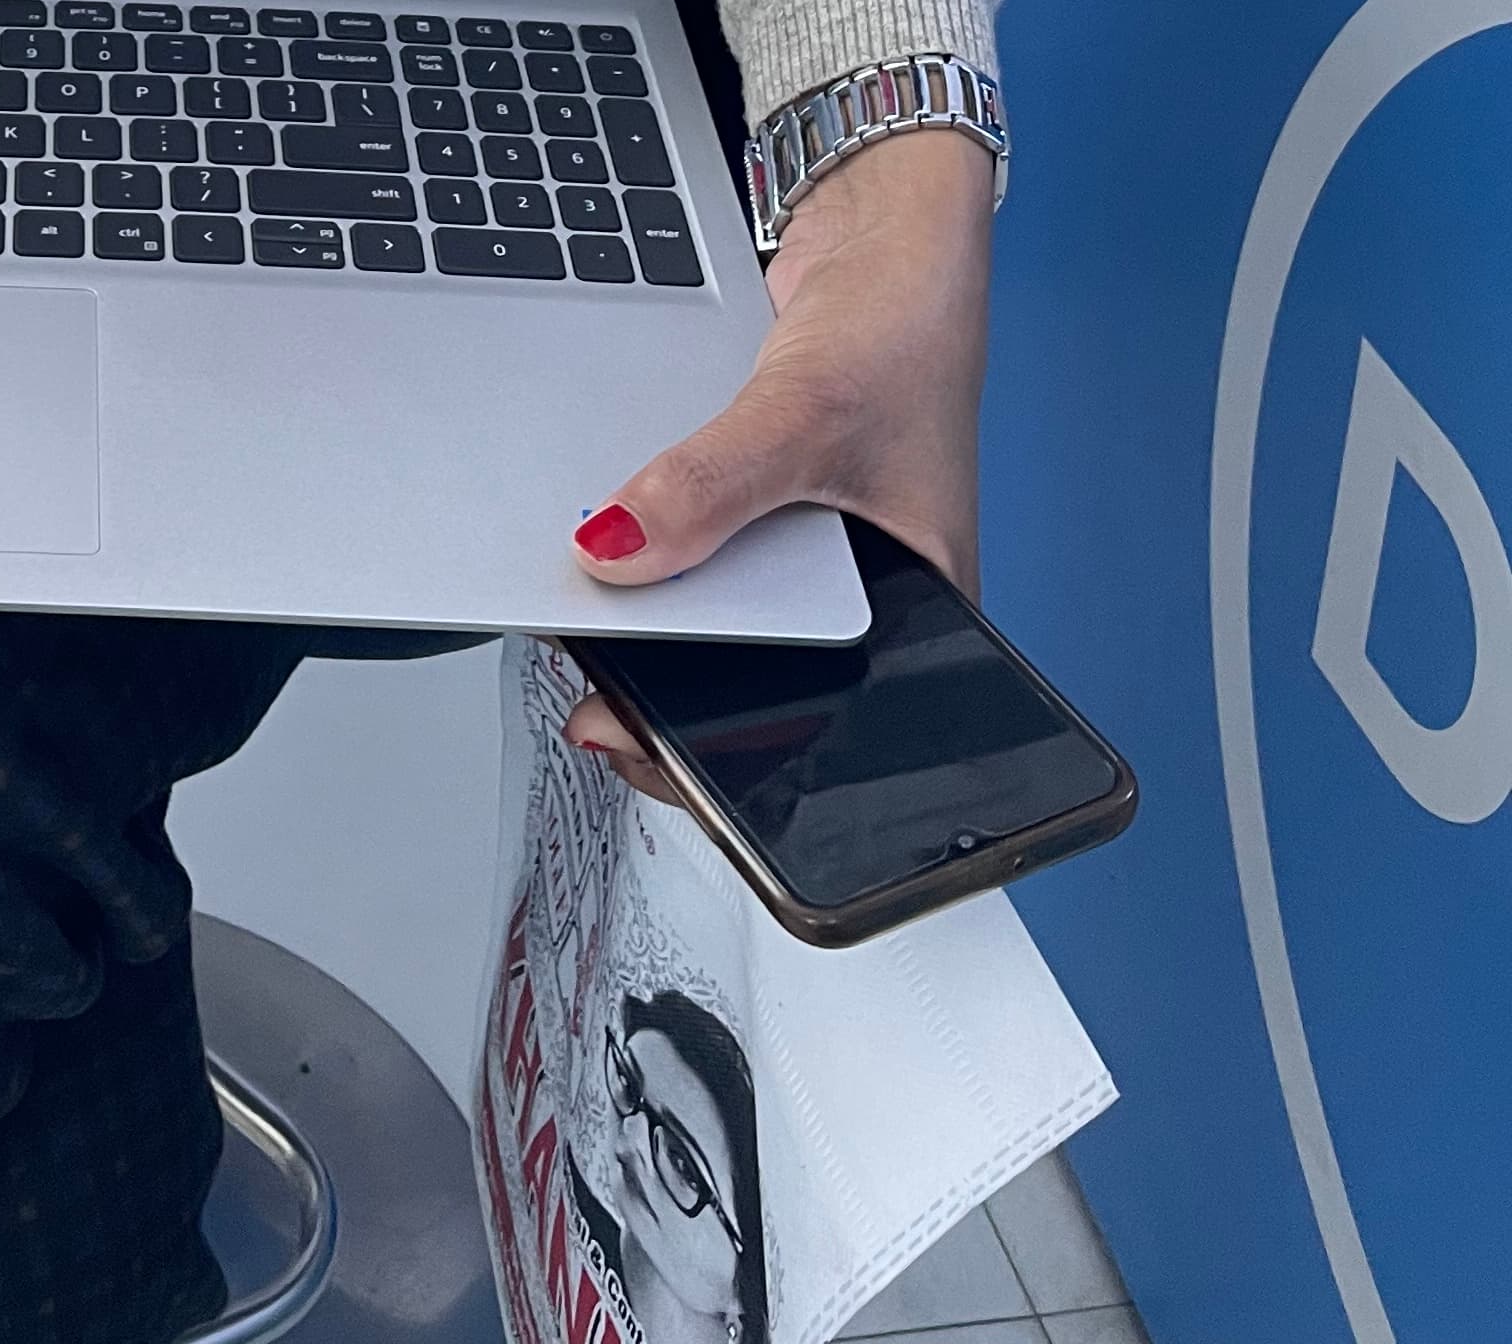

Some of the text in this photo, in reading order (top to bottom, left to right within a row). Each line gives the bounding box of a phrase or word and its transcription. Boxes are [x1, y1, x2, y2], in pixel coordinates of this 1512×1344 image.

[26, 47, 38, 59] 9
[317, 52, 378, 63] backspace
[60, 83, 77, 96] O
[136, 86, 149, 98] P
[433, 100, 443, 111] 7
[496, 103, 509, 115] 8
[560, 107, 572, 119] 9
[4, 126, 18, 139] K
[81, 129, 93, 142] L
[359, 142, 392, 151] enter
[441, 146, 453, 156] 4
[506, 148, 518, 161] 5
[571, 152, 584, 164] 6
[371, 189, 401, 199] shift
[452, 193, 461, 205] 1
[517, 196, 529, 209] 2
[584, 199, 596, 212] 3
[40, 225, 58, 235] alt
[118, 228, 141, 237] ctrl
[645, 229, 680, 238] enter
